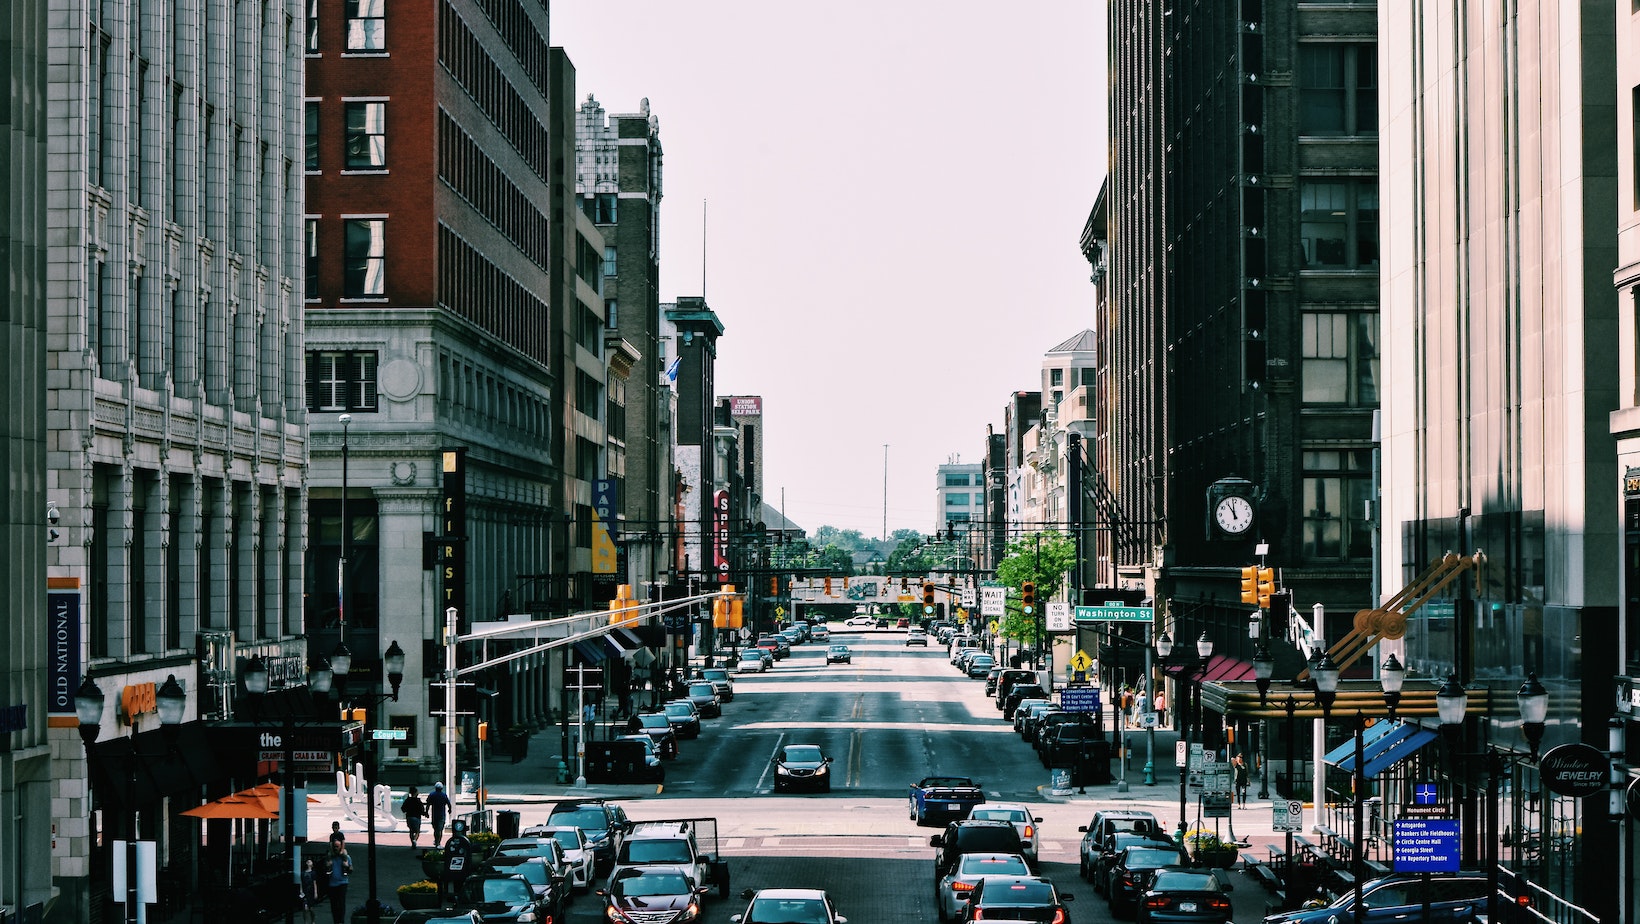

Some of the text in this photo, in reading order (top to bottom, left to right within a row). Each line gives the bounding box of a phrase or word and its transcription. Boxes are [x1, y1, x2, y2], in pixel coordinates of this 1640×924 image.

[1078, 609, 1136, 619] Washington
[57, 601, 68, 706] OLD NATIONAL
[260, 733, 281, 747] the
[1556, 772, 1603, 780] JEWELRY
